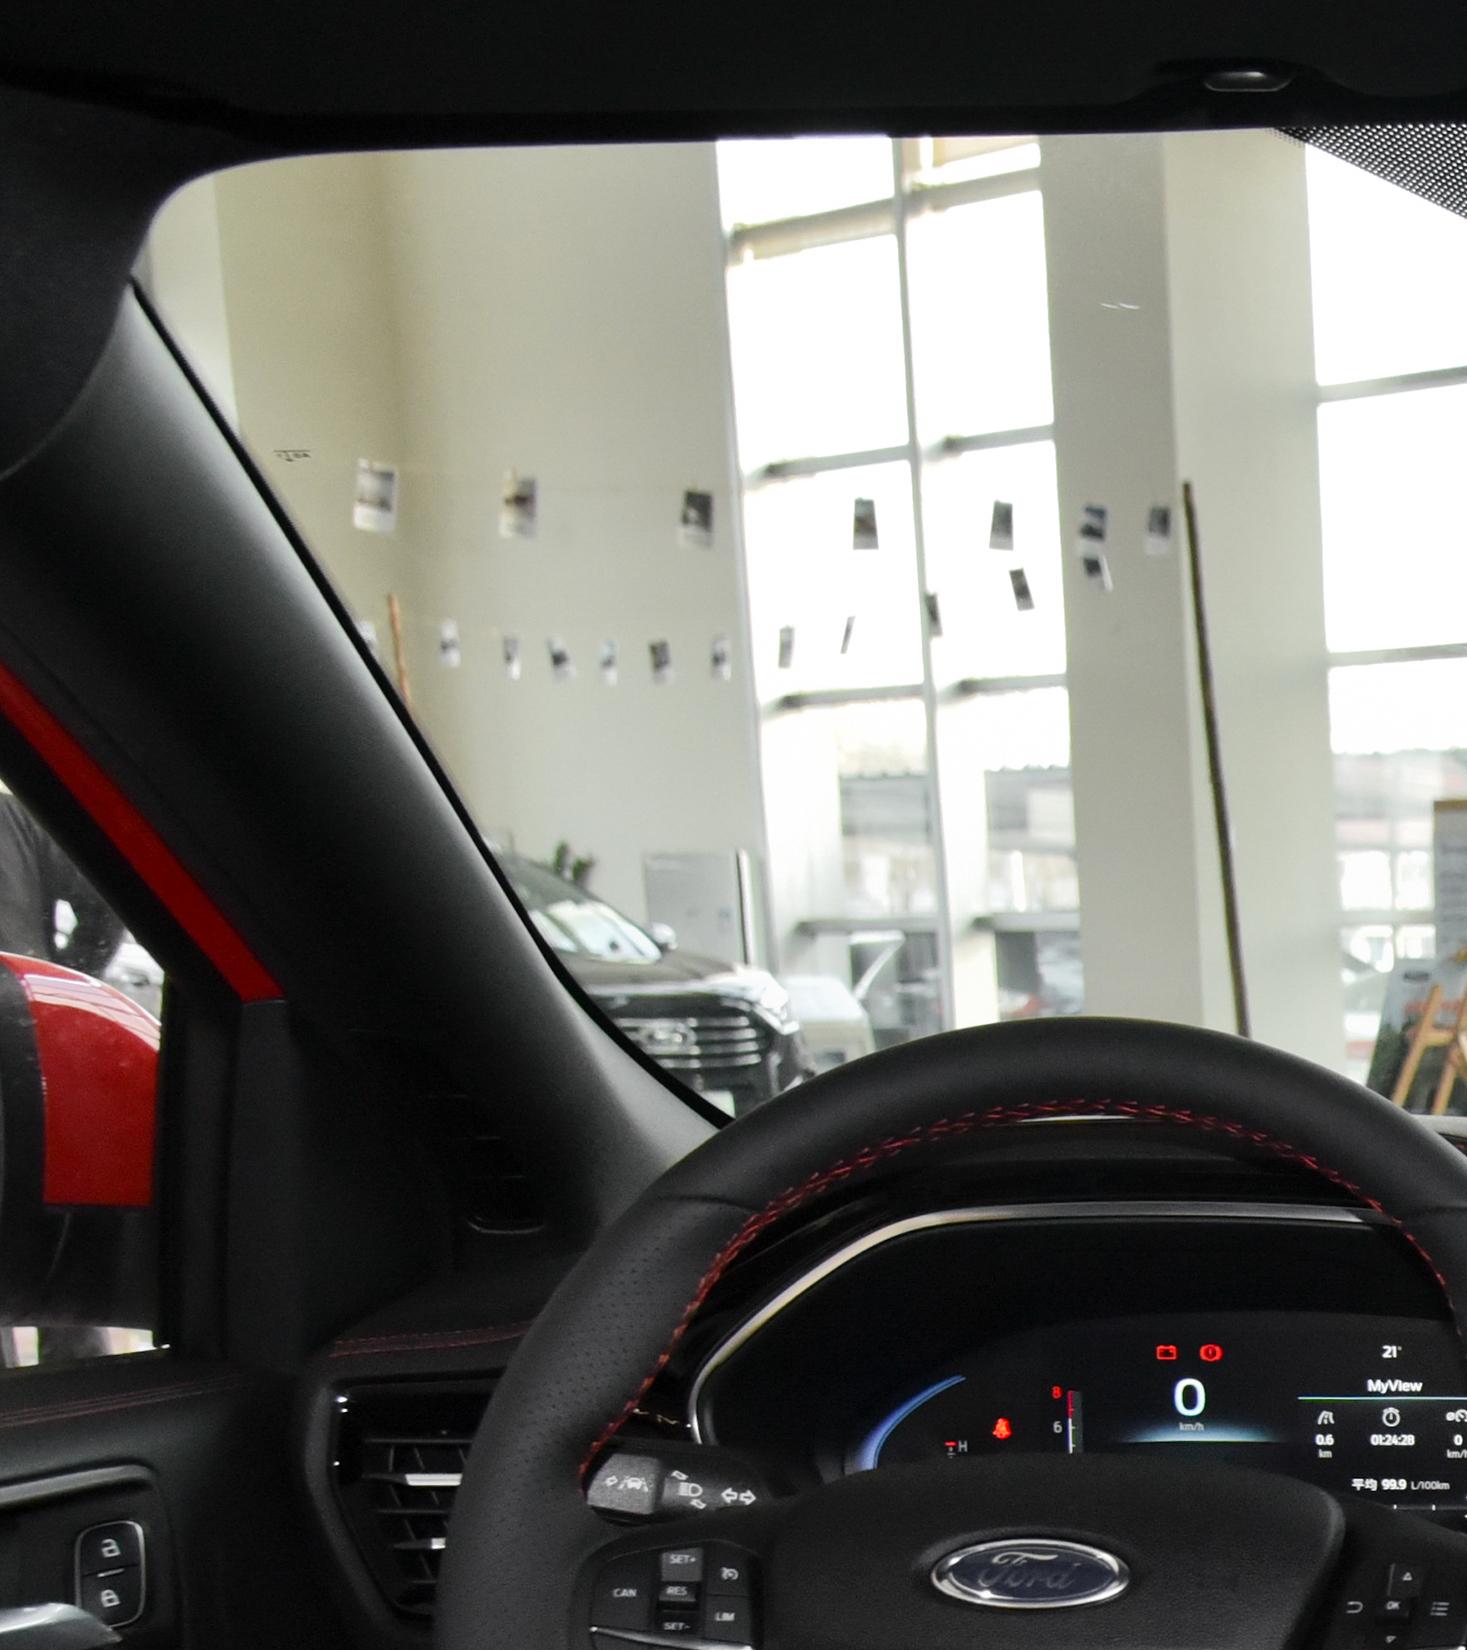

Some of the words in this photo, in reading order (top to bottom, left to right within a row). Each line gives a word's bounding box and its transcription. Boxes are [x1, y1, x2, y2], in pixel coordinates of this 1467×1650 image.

[1367, 1378, 1424, 1395] MyView
[1173, 1377, 1206, 1416] 0
[1053, 1421, 1063, 1433] 6
[1178, 1421, 1205, 1432] km/h
[1315, 1433, 1335, 1446] 0.6
[1369, 1433, 1416, 1446] 01:24:28
[1453, 1433, 1464, 1446] 0
[957, 1440, 968, 1453] H
[1318, 1448, 1333, 1459] km
[1351, 1478, 1378, 1492] 平均
[1380, 1478, 1408, 1491] 99.9
[1410, 1480, 1451, 1490] L/100km
[669, 1553, 697, 1565] SET+
[977, 1550, 1083, 1591] Ford
[612, 1587, 638, 1598] CAN
[666, 1585, 688, 1597] RES
[714, 1611, 736, 1622] LIM
